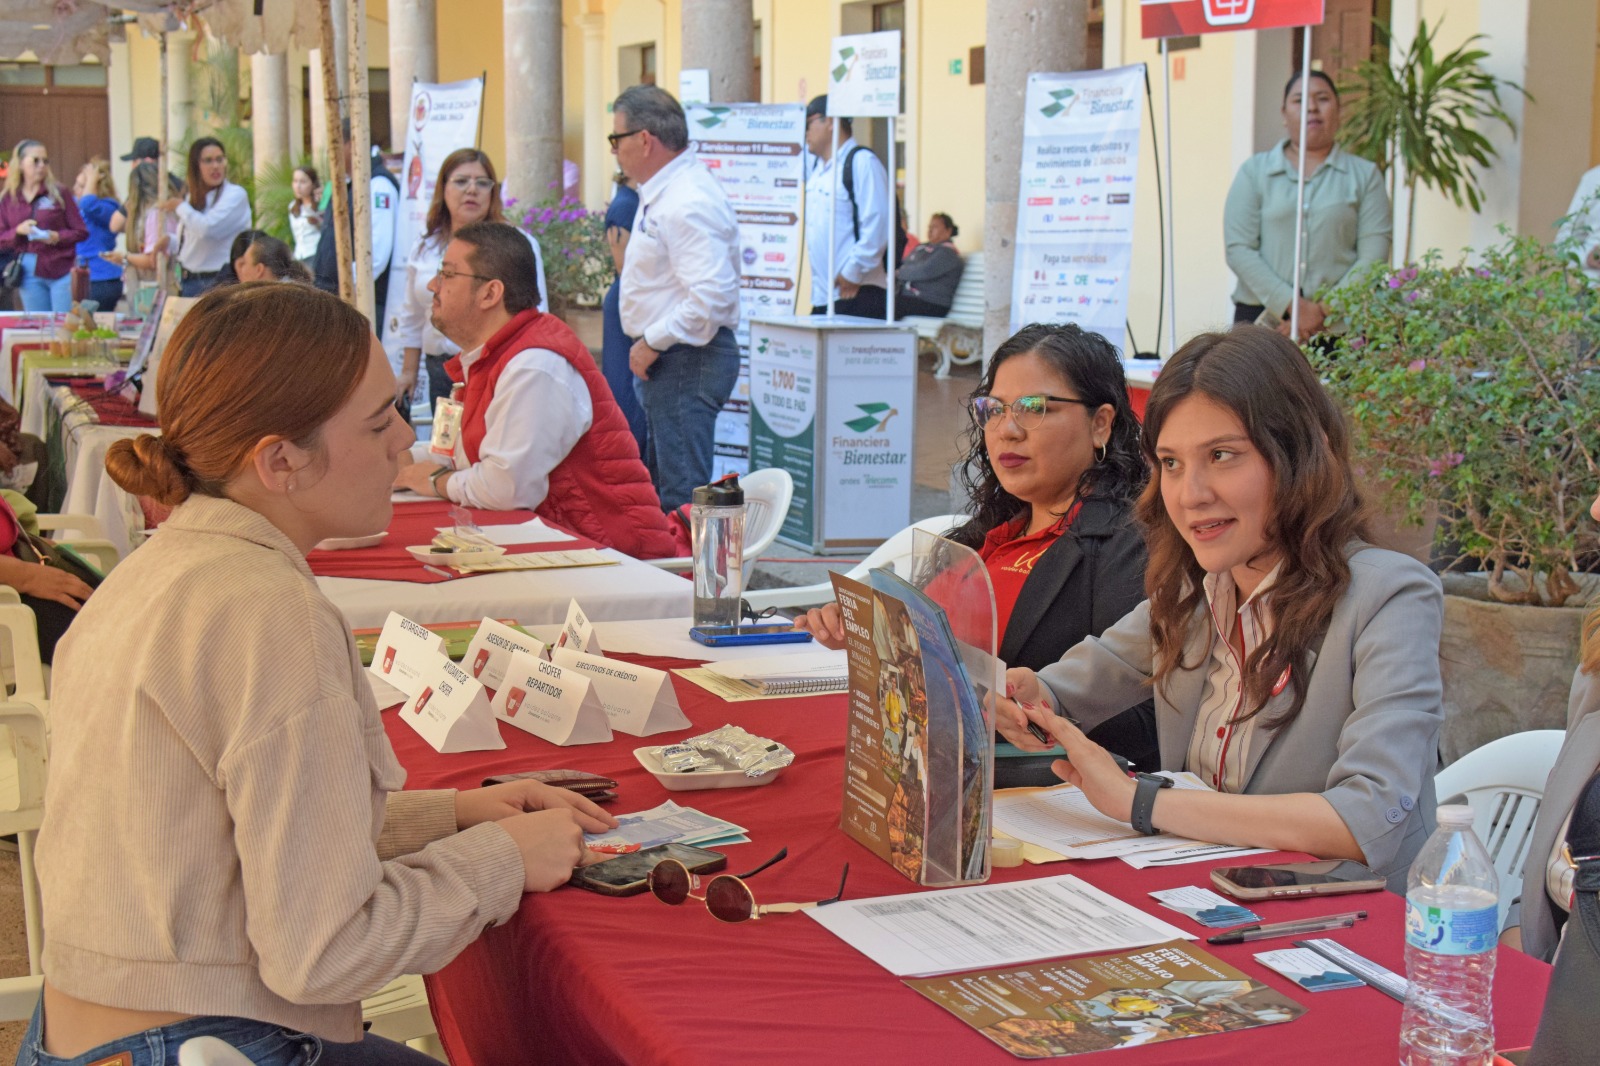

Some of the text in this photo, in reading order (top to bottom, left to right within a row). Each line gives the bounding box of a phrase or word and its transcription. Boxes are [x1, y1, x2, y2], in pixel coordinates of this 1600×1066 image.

[701, 143, 791, 153] Servicios con 11 Bancos
[1037, 145, 1060, 156] Realiza
[1124, 142, 1130, 153] y
[1036, 159, 1081, 169] movimientos
[1083, 158, 1092, 168] de
[737, 212, 790, 222] nternacionales
[1044, 254, 1106, 265] Paga tus servicios
[851, 345, 905, 355] transformamos
[845, 356, 860, 365] para
[773, 369, 795, 391] 1,700
[764, 393, 806, 412] EN TODO EL PAÍS
[832, 436, 890, 448] Financiera
[839, 477, 860, 485] antes
[839, 593, 858, 611] FERIA
[842, 606, 855, 620] DEL
[401, 618, 429, 641] BOTARGUERO
[845, 619, 870, 640] EMPLEO
[486, 632, 504, 646] ASESOR
[848, 637, 872, 656] EL FUERTE
[852, 650, 871, 667] SINALOA
[443, 661, 469, 685] AYUDANTE DE
[538, 662, 562, 679] CHOFER
[576, 661, 637, 682] EJECUTIVOS DE CRÉDITO
[439, 680, 453, 697] CHOFER
[526, 676, 562, 699] REPARTIDOR
[856, 710, 880, 730] GUÍA TURÍSTICO
[1141, 952, 1166, 964] DEL
[1155, 948, 1190, 968] FERIA
[1101, 961, 1136, 981] SINALOA
[1110, 957, 1156, 981] EL FUERTE
[1127, 955, 1174, 979] EMPLEO
[1043, 972, 1085, 996] GUÍA TURÍSTICO
[1054, 970, 1087, 989] BARTENDER
[1065, 968, 1092, 984] MESEROS
